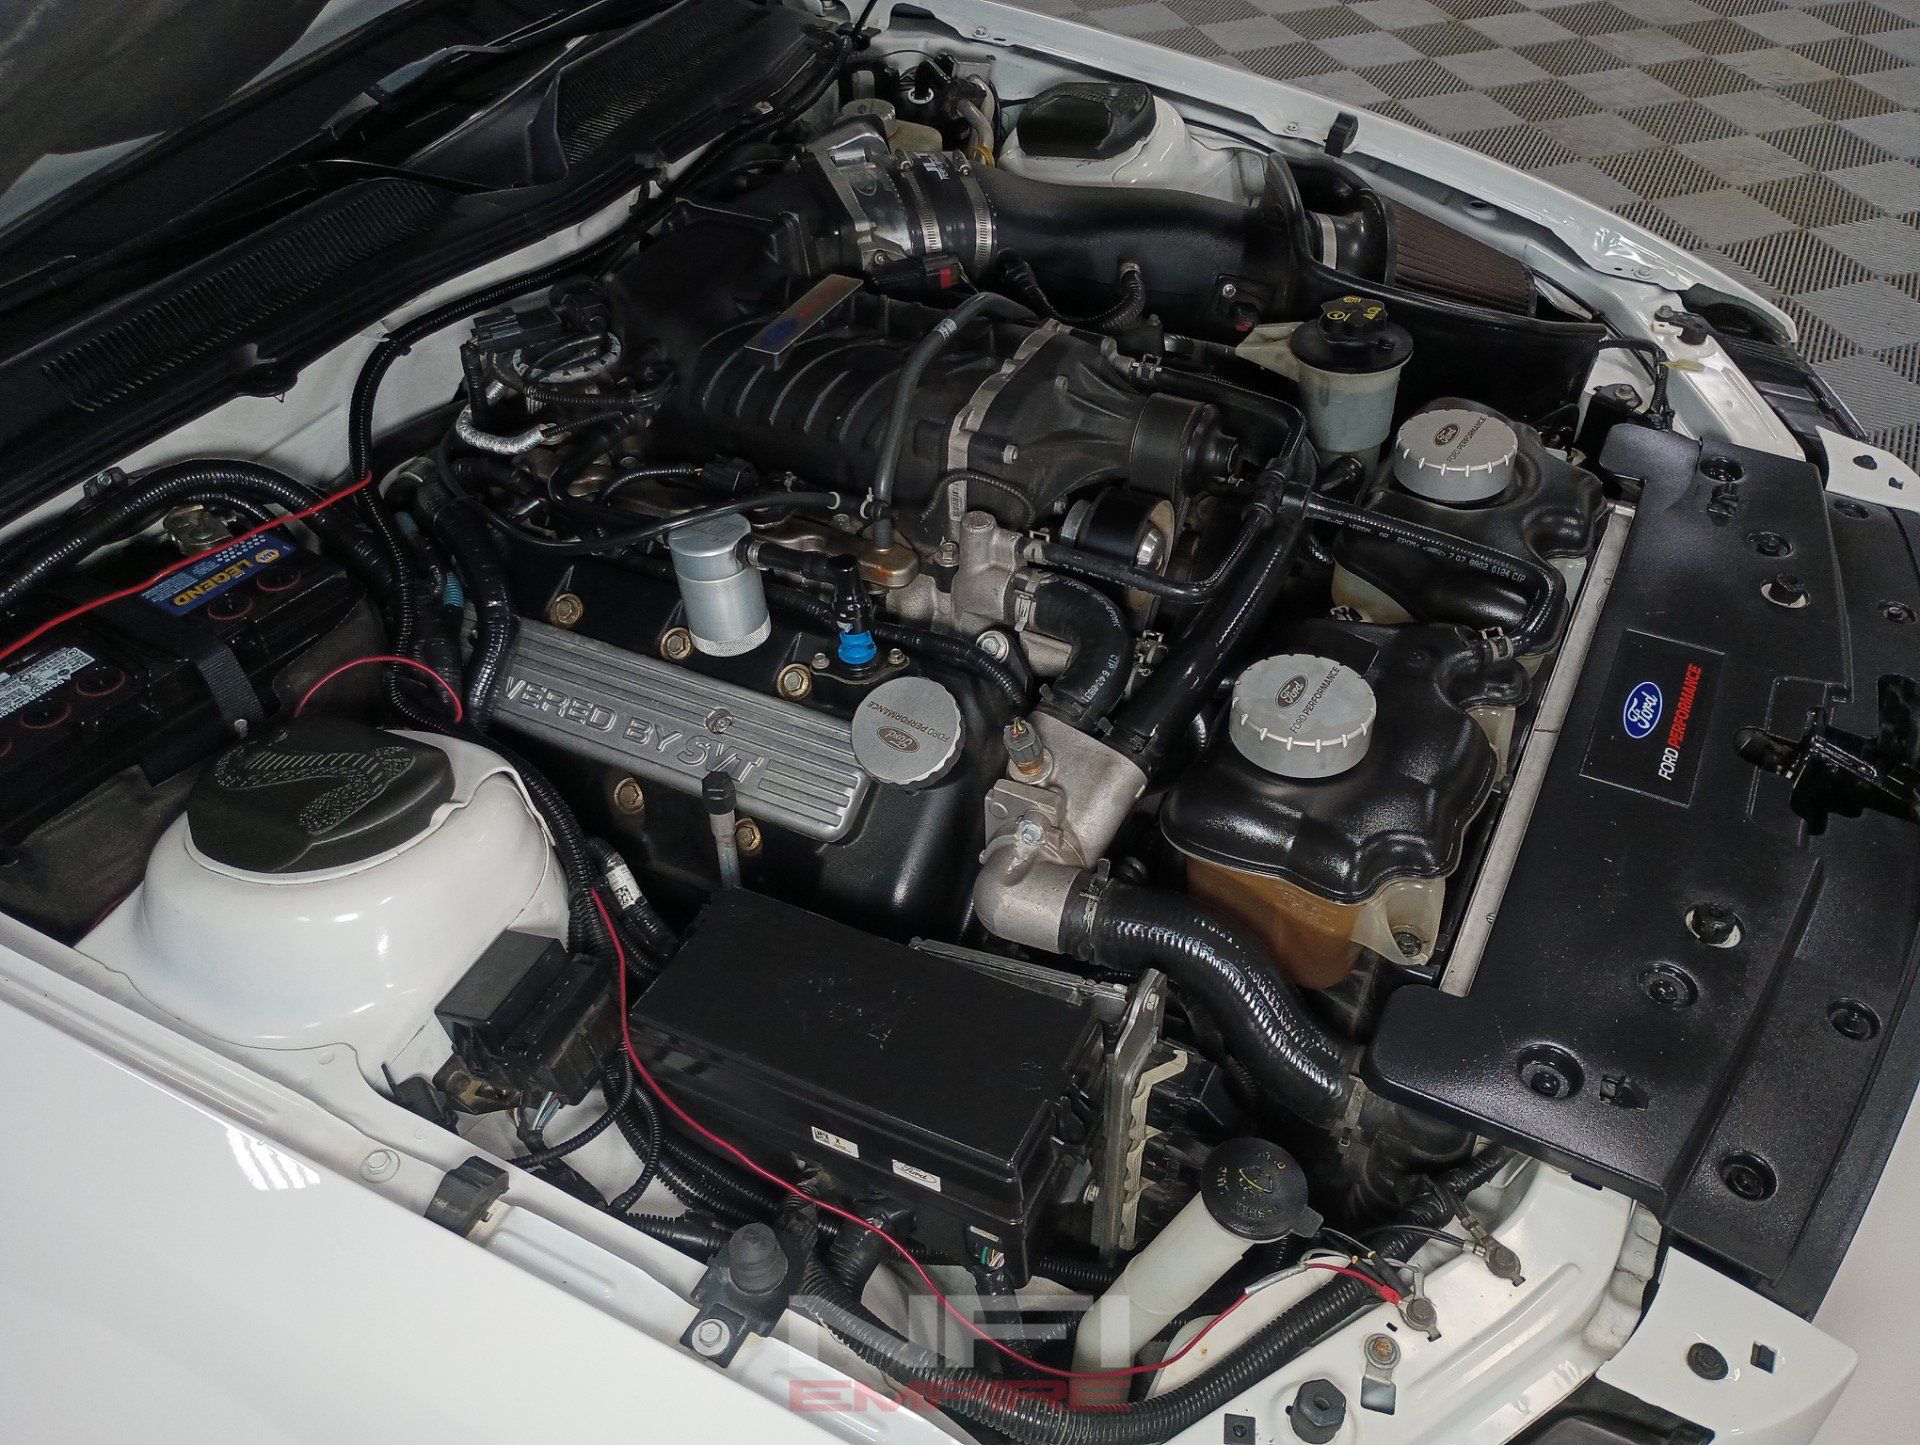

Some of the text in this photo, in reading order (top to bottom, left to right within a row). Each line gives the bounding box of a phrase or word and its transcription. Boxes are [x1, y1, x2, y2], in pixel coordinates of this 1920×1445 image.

[173, 559, 254, 607] LEGEND
[1280, 679, 1305, 704] Ford
[1290, 666, 1341, 734] FORD PERFORMANCE
[1627, 690, 1658, 729] Ford
[866, 700, 951, 743] FORD PERFORMANCE
[1658, 663, 1702, 781] FORD PERFORMANCE
[622, 716, 682, 752] BY
[676, 735, 764, 783] SVT
